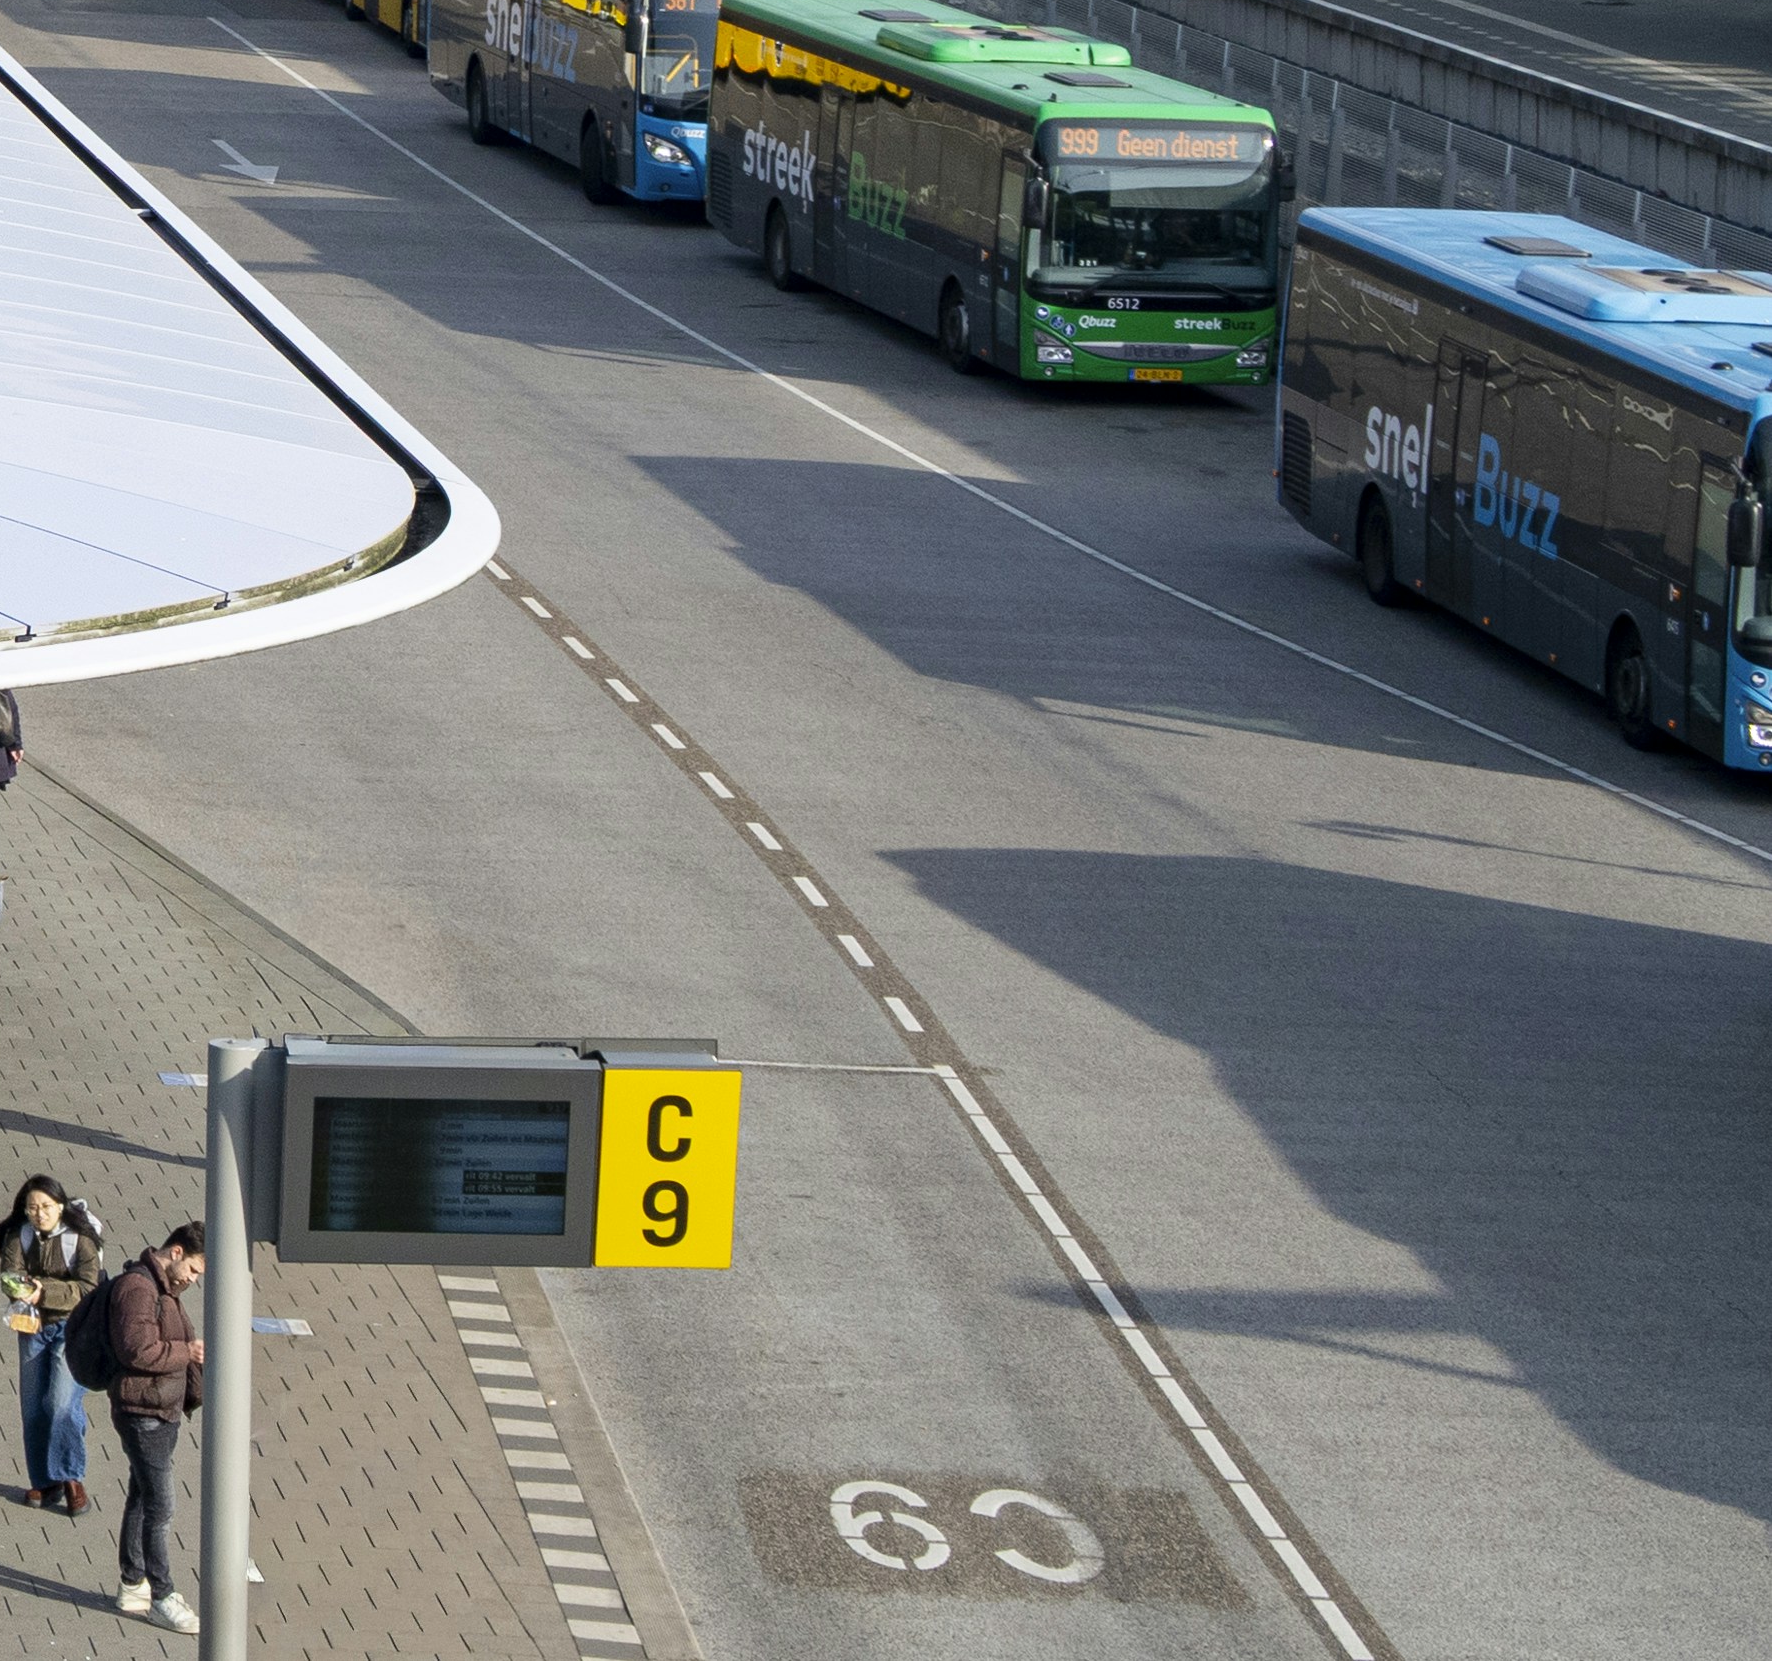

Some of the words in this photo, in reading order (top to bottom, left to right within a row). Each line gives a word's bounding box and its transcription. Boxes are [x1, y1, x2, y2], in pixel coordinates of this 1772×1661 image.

[1061, 127, 1099, 156] 999
[1117, 128, 1167, 158] Geen
[1171, 130, 1239, 160] dienst
[743, 120, 817, 202] streek
[848, 150, 909, 241] Buzz
[1078, 314, 1117, 329] Qbuzz
[1108, 298, 1140, 310] 6512
[1365, 403, 1433, 495] snel
[1474, 432, 1561, 561] Buzz
[646, 1095, 692, 1163] C
[642, 1180, 689, 1248] 9
